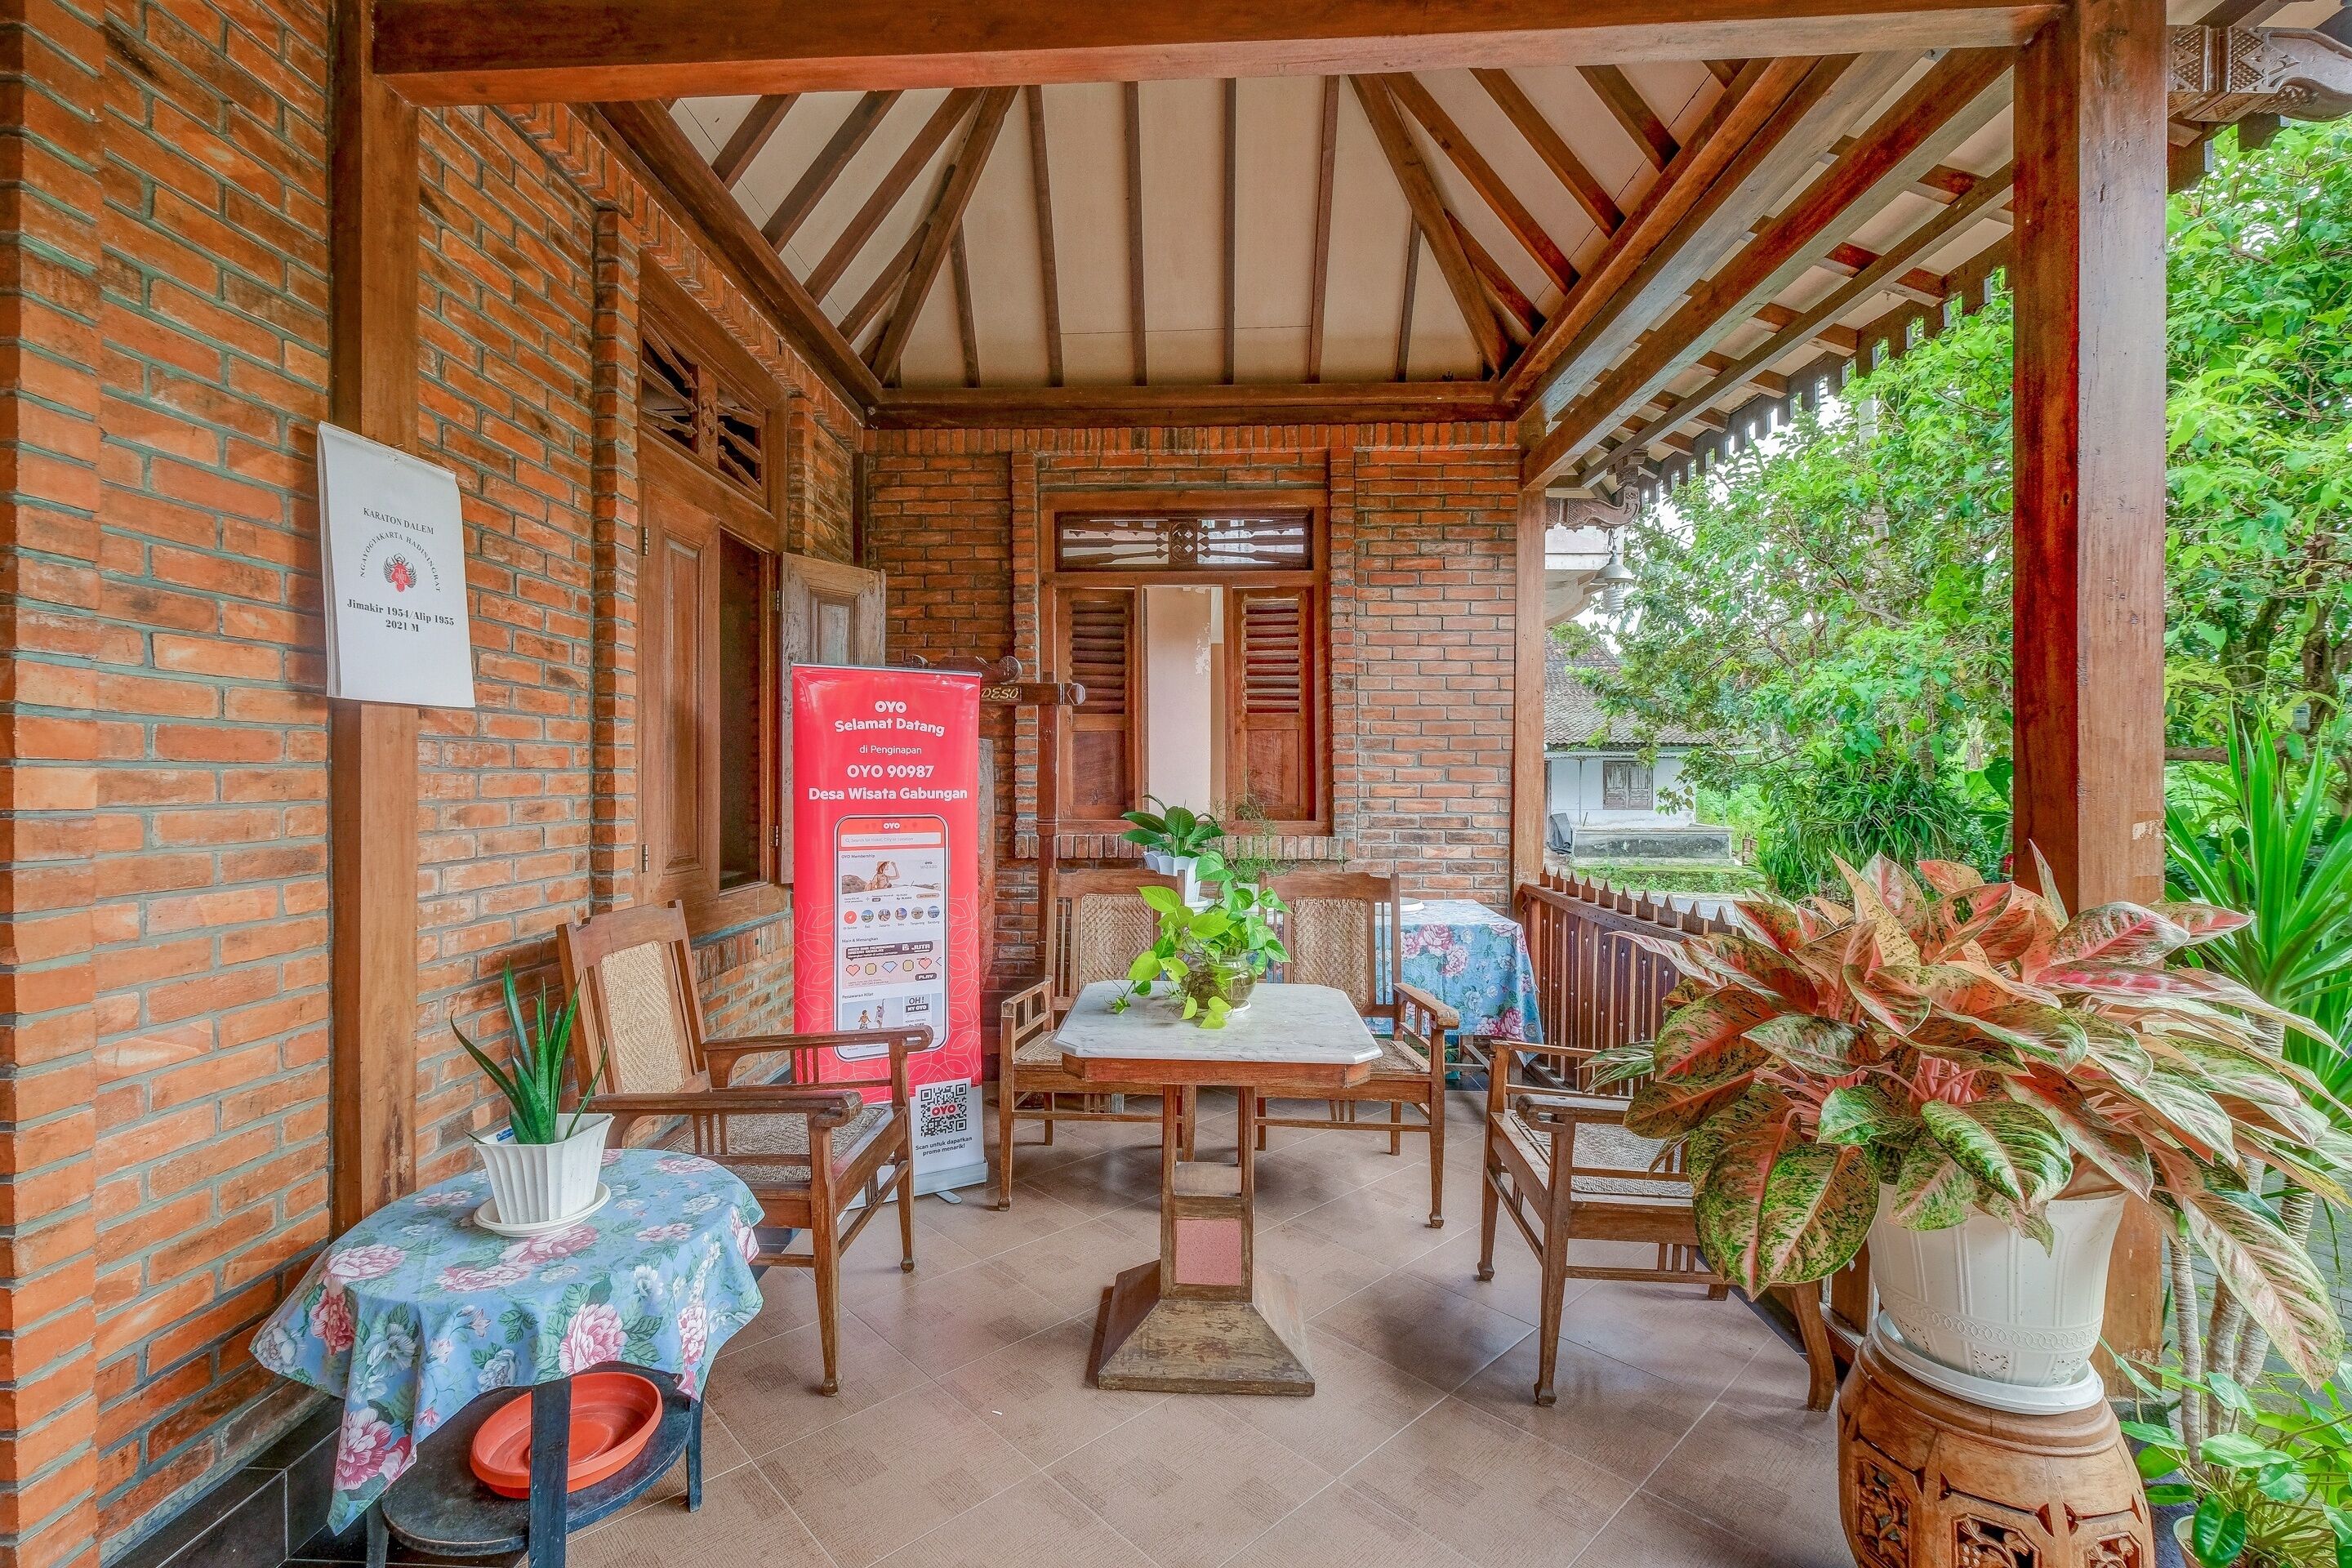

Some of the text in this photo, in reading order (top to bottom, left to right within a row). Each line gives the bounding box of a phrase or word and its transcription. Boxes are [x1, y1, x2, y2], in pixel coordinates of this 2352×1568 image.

[363, 507, 434, 535] KARATON DALEM
[360, 532, 442, 593] NGAYOGYAKARTA HADININGRAT
[347, 599, 455, 626] Jimakir 1954/Alip 1955
[385, 619, 420, 632] 2021 M
[874, 701, 907, 713] OYO
[834, 717, 946, 737] Selamat Datang
[859, 745, 922, 755] di Penginapan
[846, 764, 935, 778] OYO 90987
[808, 787, 968, 802] Desa Wisata Gabungan
[931, 1104, 956, 1116] OYO
[947, 1136, 973, 1145] dapatkan
[922, 1143, 965, 1156] promo menarik!
